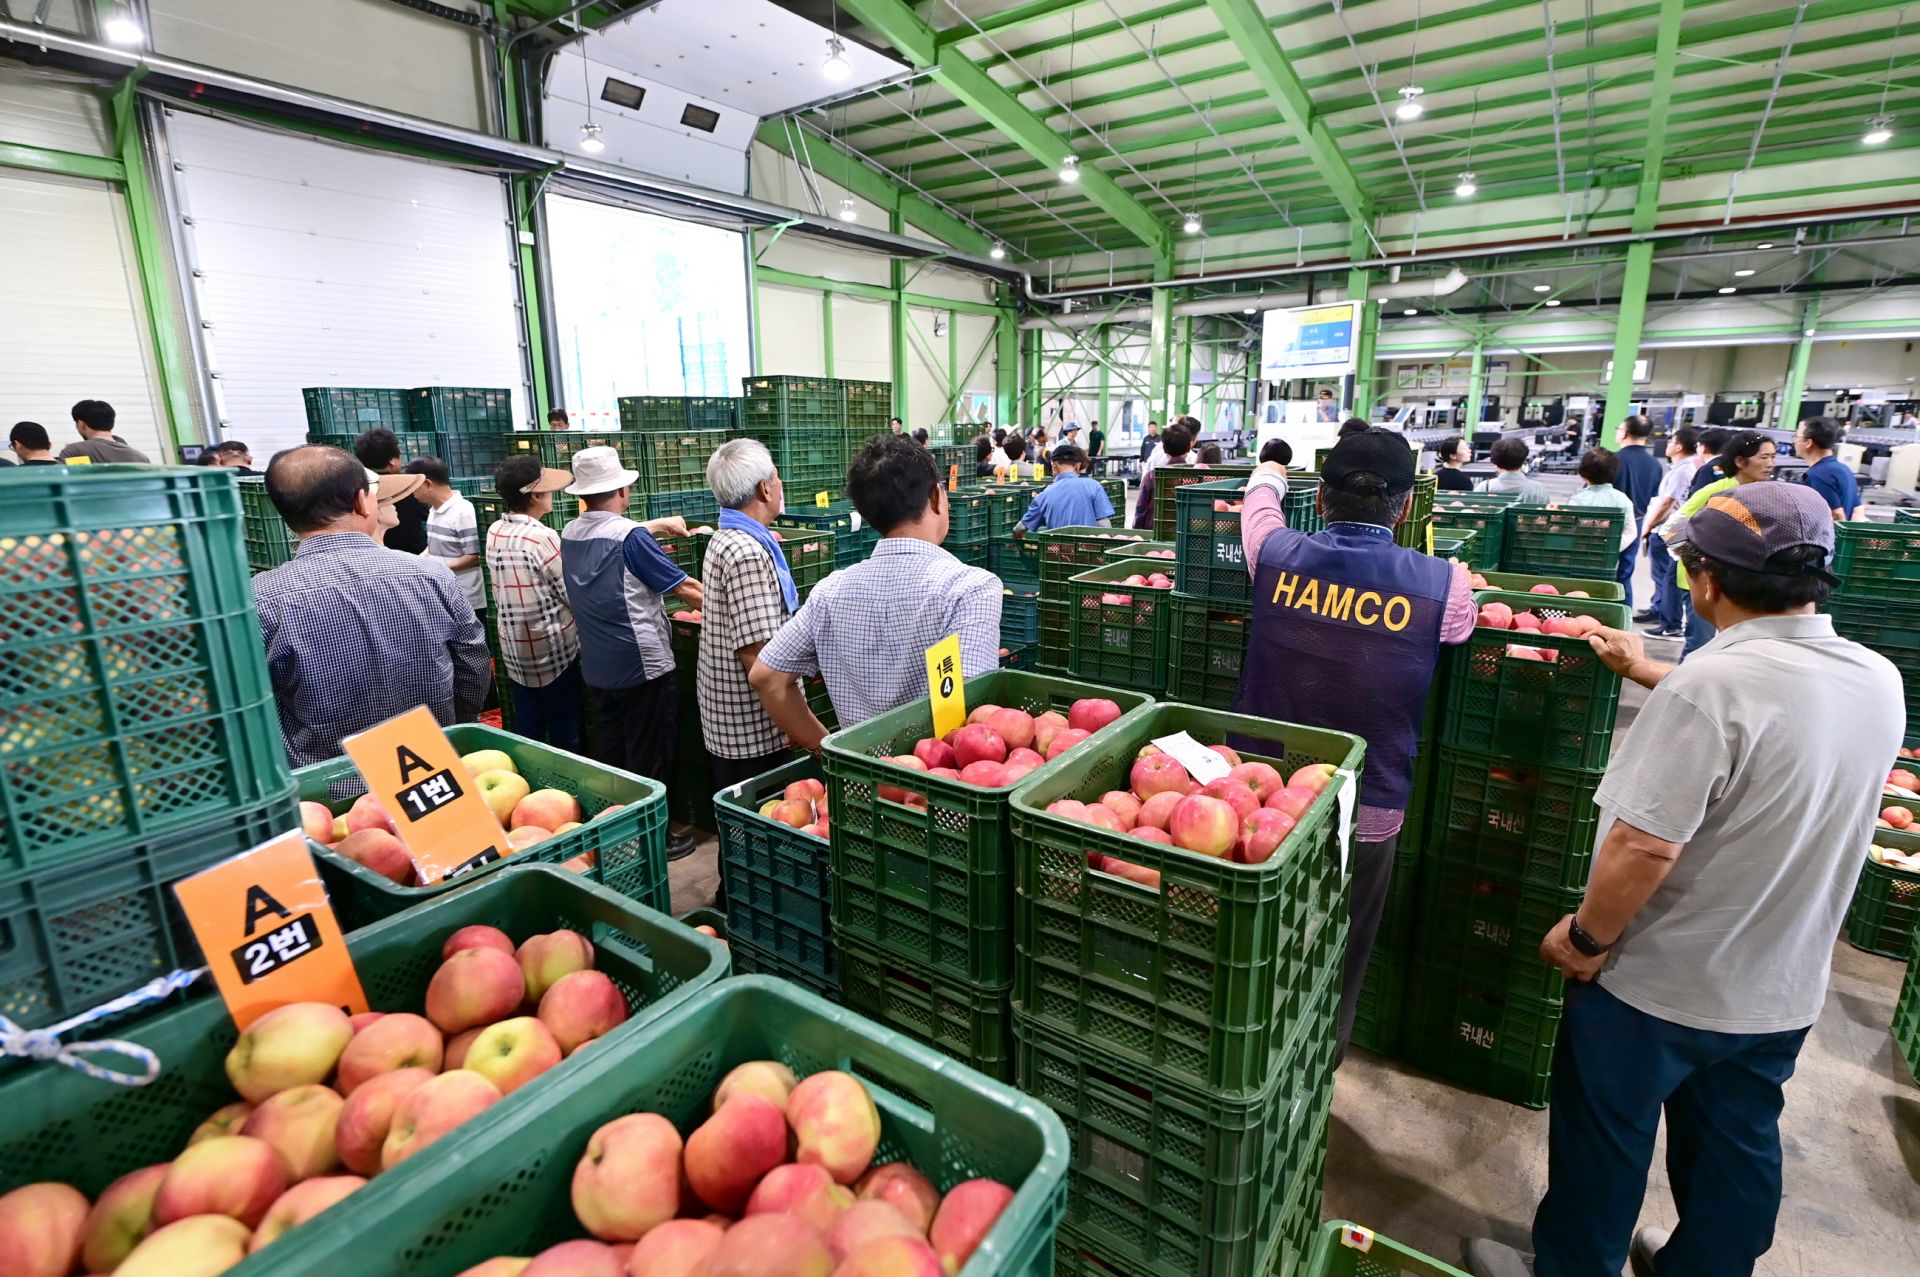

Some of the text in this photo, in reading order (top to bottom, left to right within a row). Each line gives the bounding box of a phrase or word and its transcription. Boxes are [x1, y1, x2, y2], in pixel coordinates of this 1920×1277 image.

[1217, 543, 1243, 563] 국내산
[1272, 571, 1412, 632] HAMCO
[1104, 628, 1129, 648] 국내산
[937, 655, 954, 679] 1특
[396, 744, 435, 785] A
[407, 774, 455, 813] 1번
[243, 884, 292, 938] A
[244, 920, 312, 976] 2번
[1473, 919, 1511, 946] 국내산
[1460, 1021, 1495, 1050] 국내산
